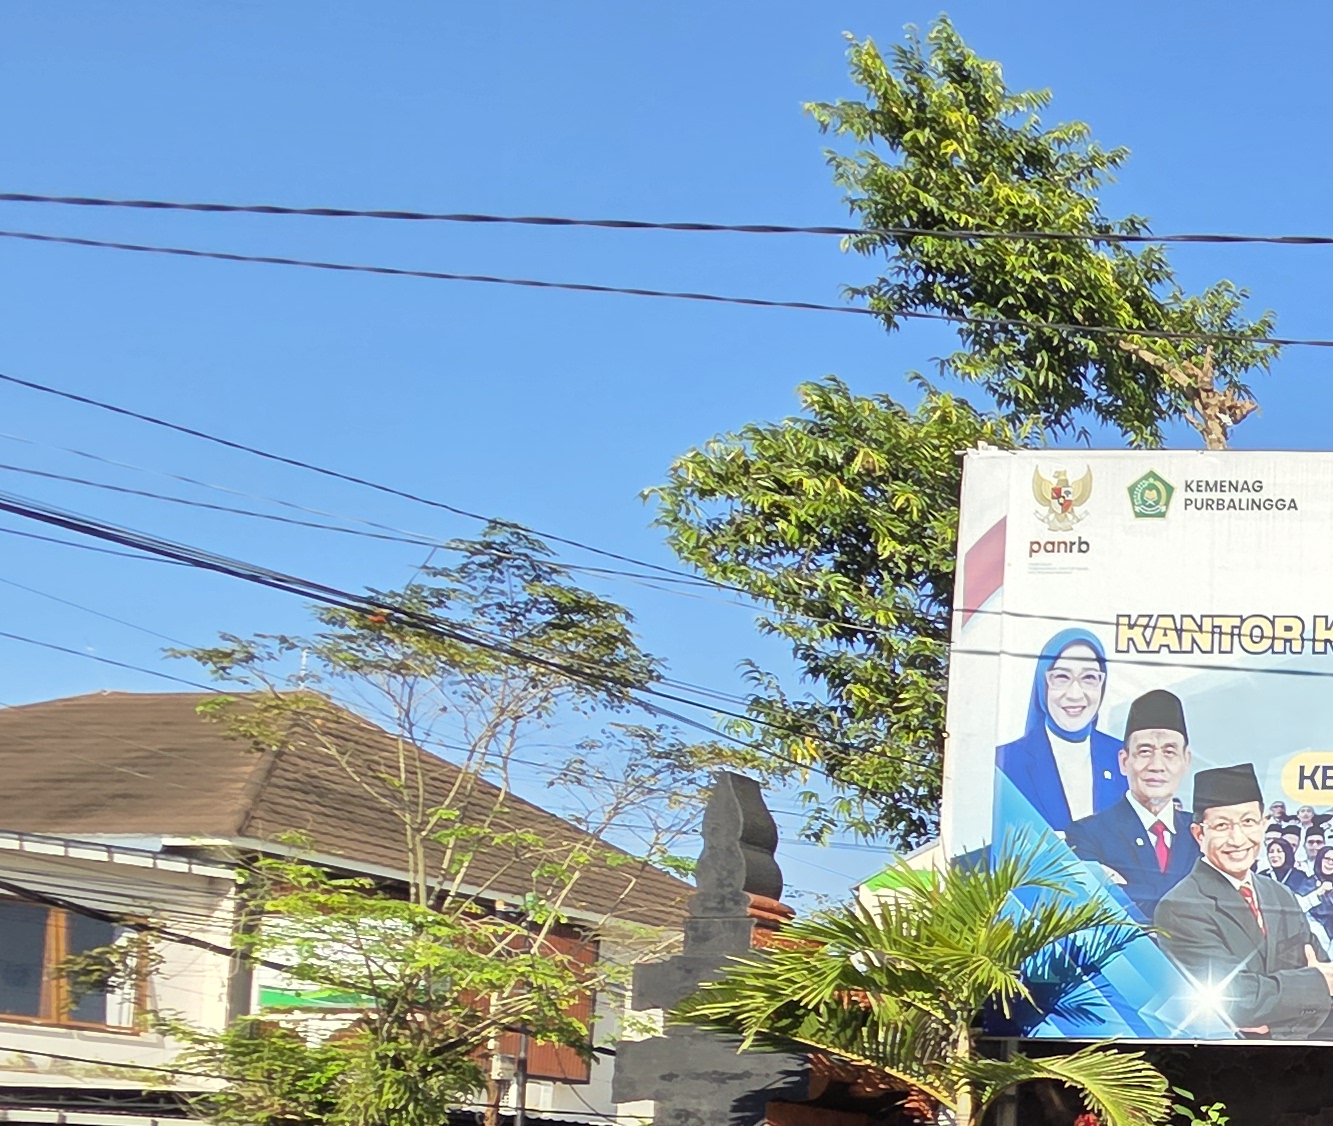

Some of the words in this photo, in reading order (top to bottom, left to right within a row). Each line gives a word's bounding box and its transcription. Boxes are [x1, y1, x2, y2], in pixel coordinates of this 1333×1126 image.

[1184, 479, 1264, 493] KEMENAG
[1184, 498, 1299, 511] PURBALINGGA
[1029, 536, 1090, 558] panrb
[1115, 614, 1304, 656] KANTOR
